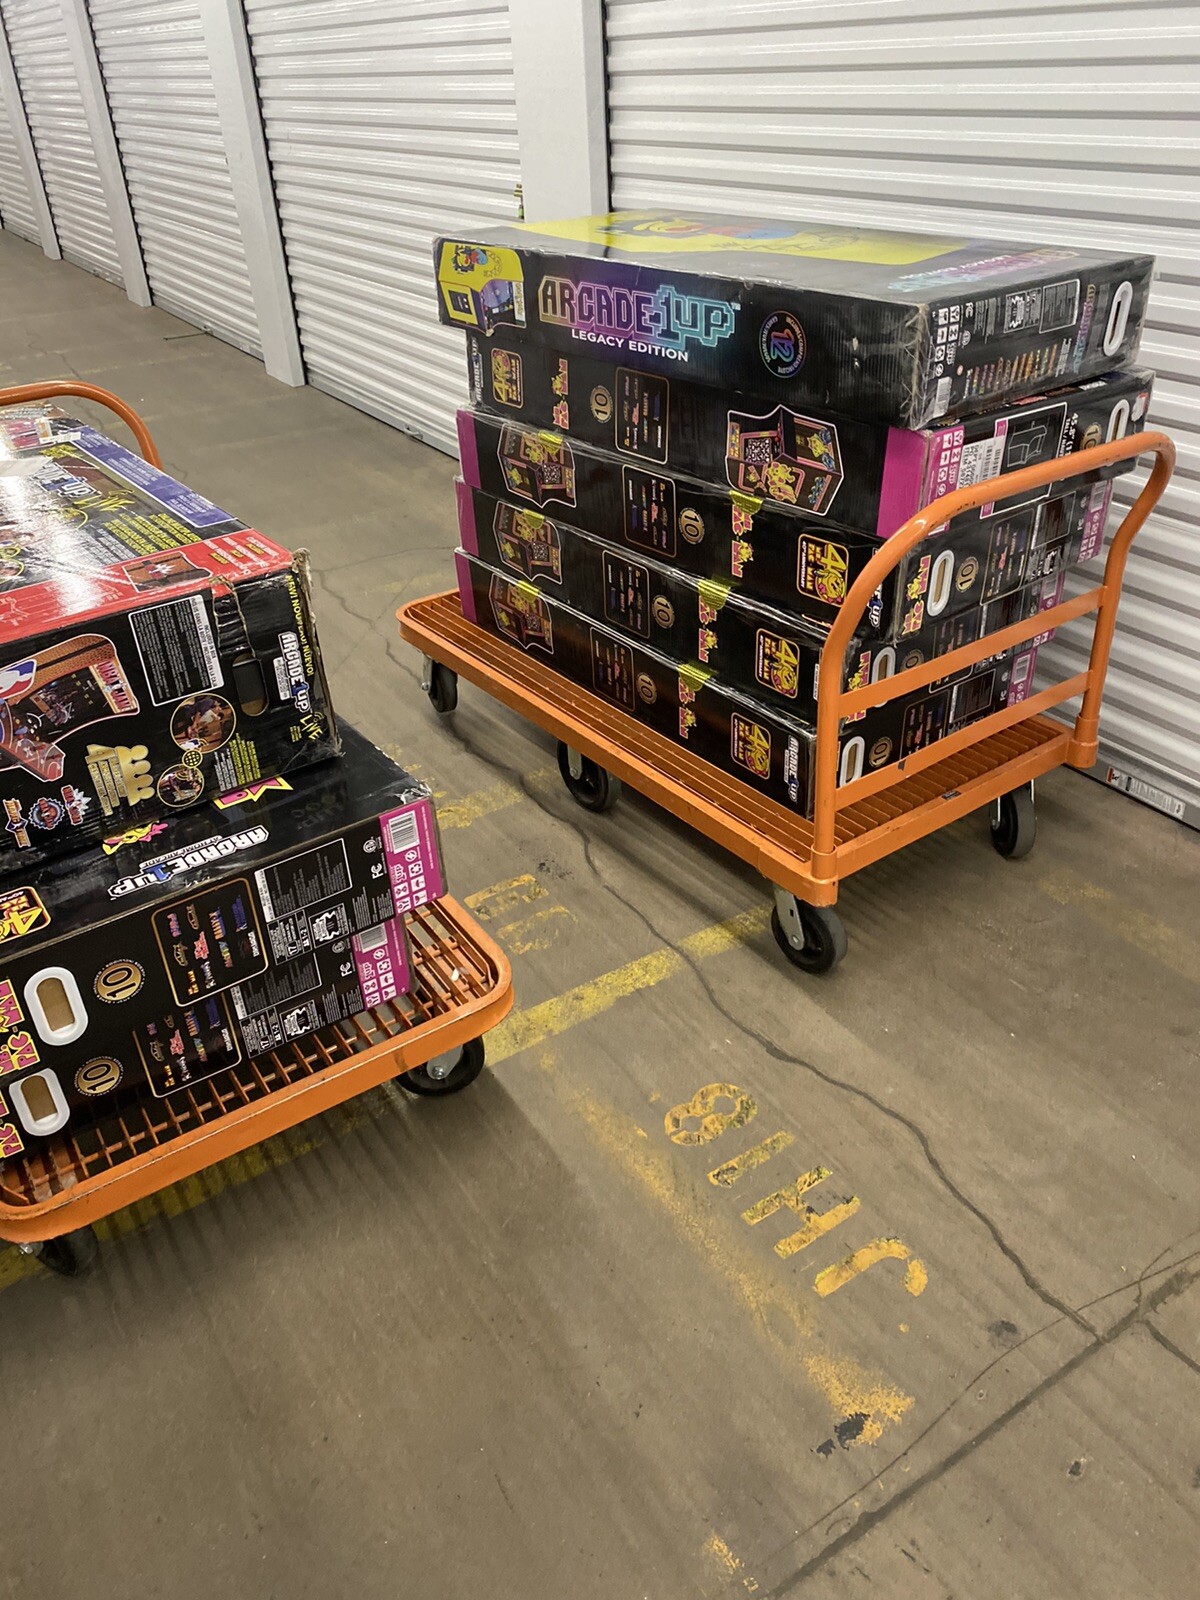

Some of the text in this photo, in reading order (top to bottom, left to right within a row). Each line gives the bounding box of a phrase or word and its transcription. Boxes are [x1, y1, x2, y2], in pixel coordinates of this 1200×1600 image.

[572, 329, 689, 362] LEGACY EDITION
[594, 393, 608, 416] 10
[684, 511, 699, 537] 10
[959, 564, 974, 587] 10
[911, 555, 931, 632] PAC-MAN
[655, 597, 670, 623] 10
[279, 632, 313, 713] ARCADE1UP
[302, 645, 315, 676] NUEVO!
[96, 661, 132, 710] NBA JAM
[640, 675, 654, 699] 10
[142, 851, 179, 868] ARCADE
[179, 841, 208, 855] HOME
[107, 824, 269, 900] ARCADE1UP
[300, 929, 308, 940] 1-2
[288, 945, 298, 955] 17
[105, 965, 133, 999] 10
[272, 1024, 280, 1034] 1-2
[260, 1039, 270, 1049] 17
[85, 1062, 112, 1094] 10
